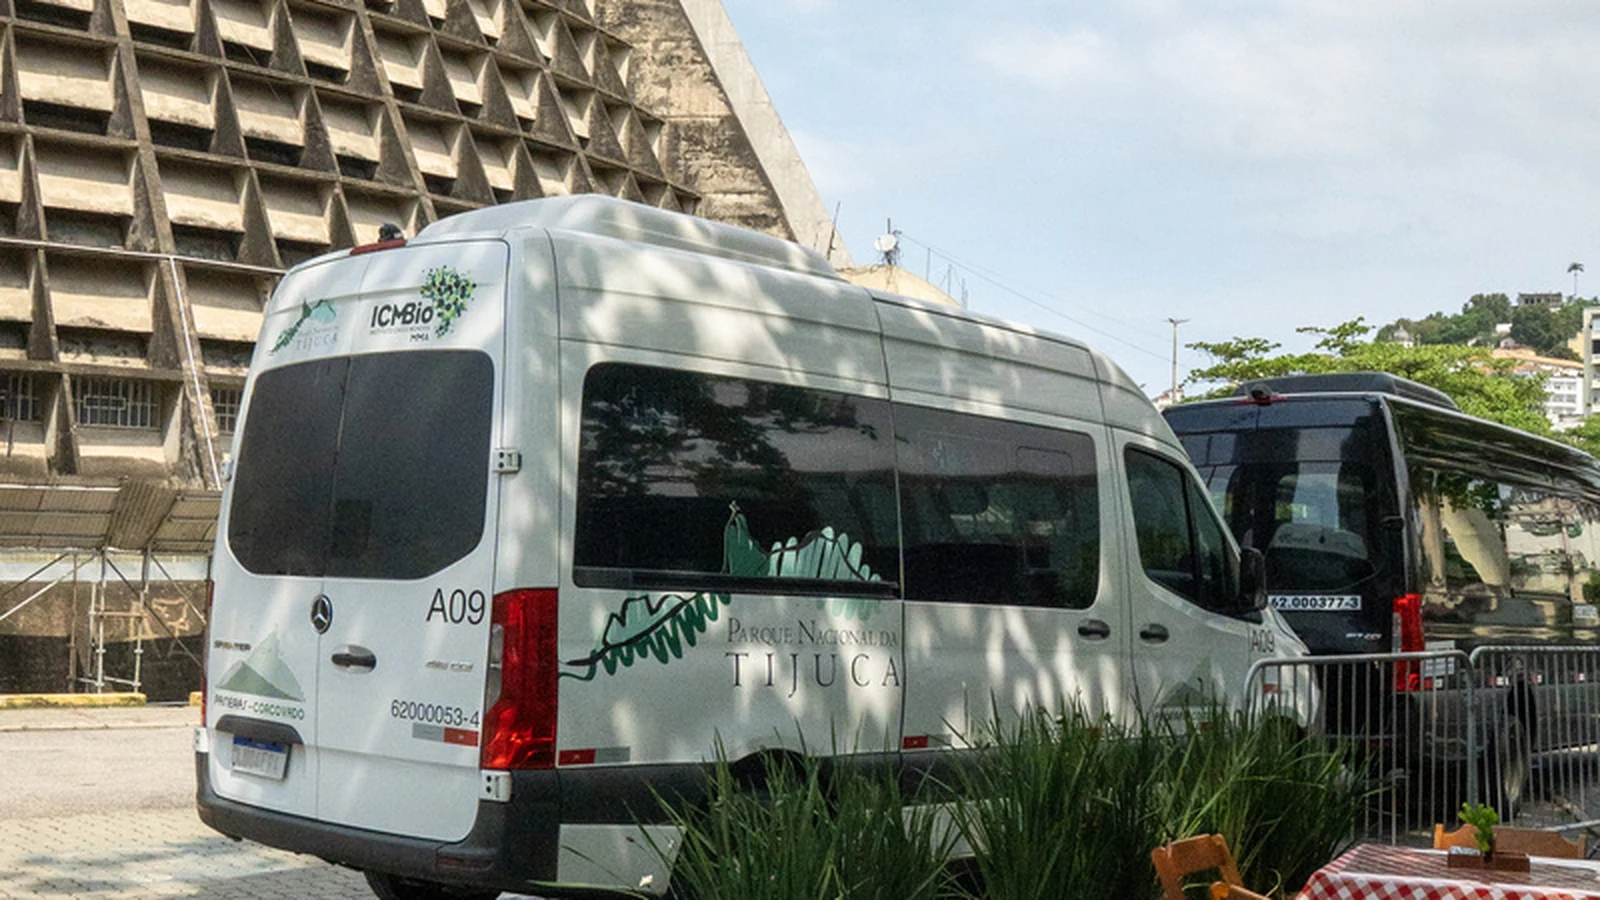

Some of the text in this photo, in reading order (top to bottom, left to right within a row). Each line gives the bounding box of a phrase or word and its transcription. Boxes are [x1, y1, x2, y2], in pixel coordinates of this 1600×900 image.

[370, 302, 434, 328] ICMBio
[426, 588, 485, 625] A09
[1271, 597, 1359, 609] 62.000377-3
[1251, 629, 1275, 653] A09
[725, 652, 900, 698] TIJUCA
[391, 699, 480, 728] 62000053-4
